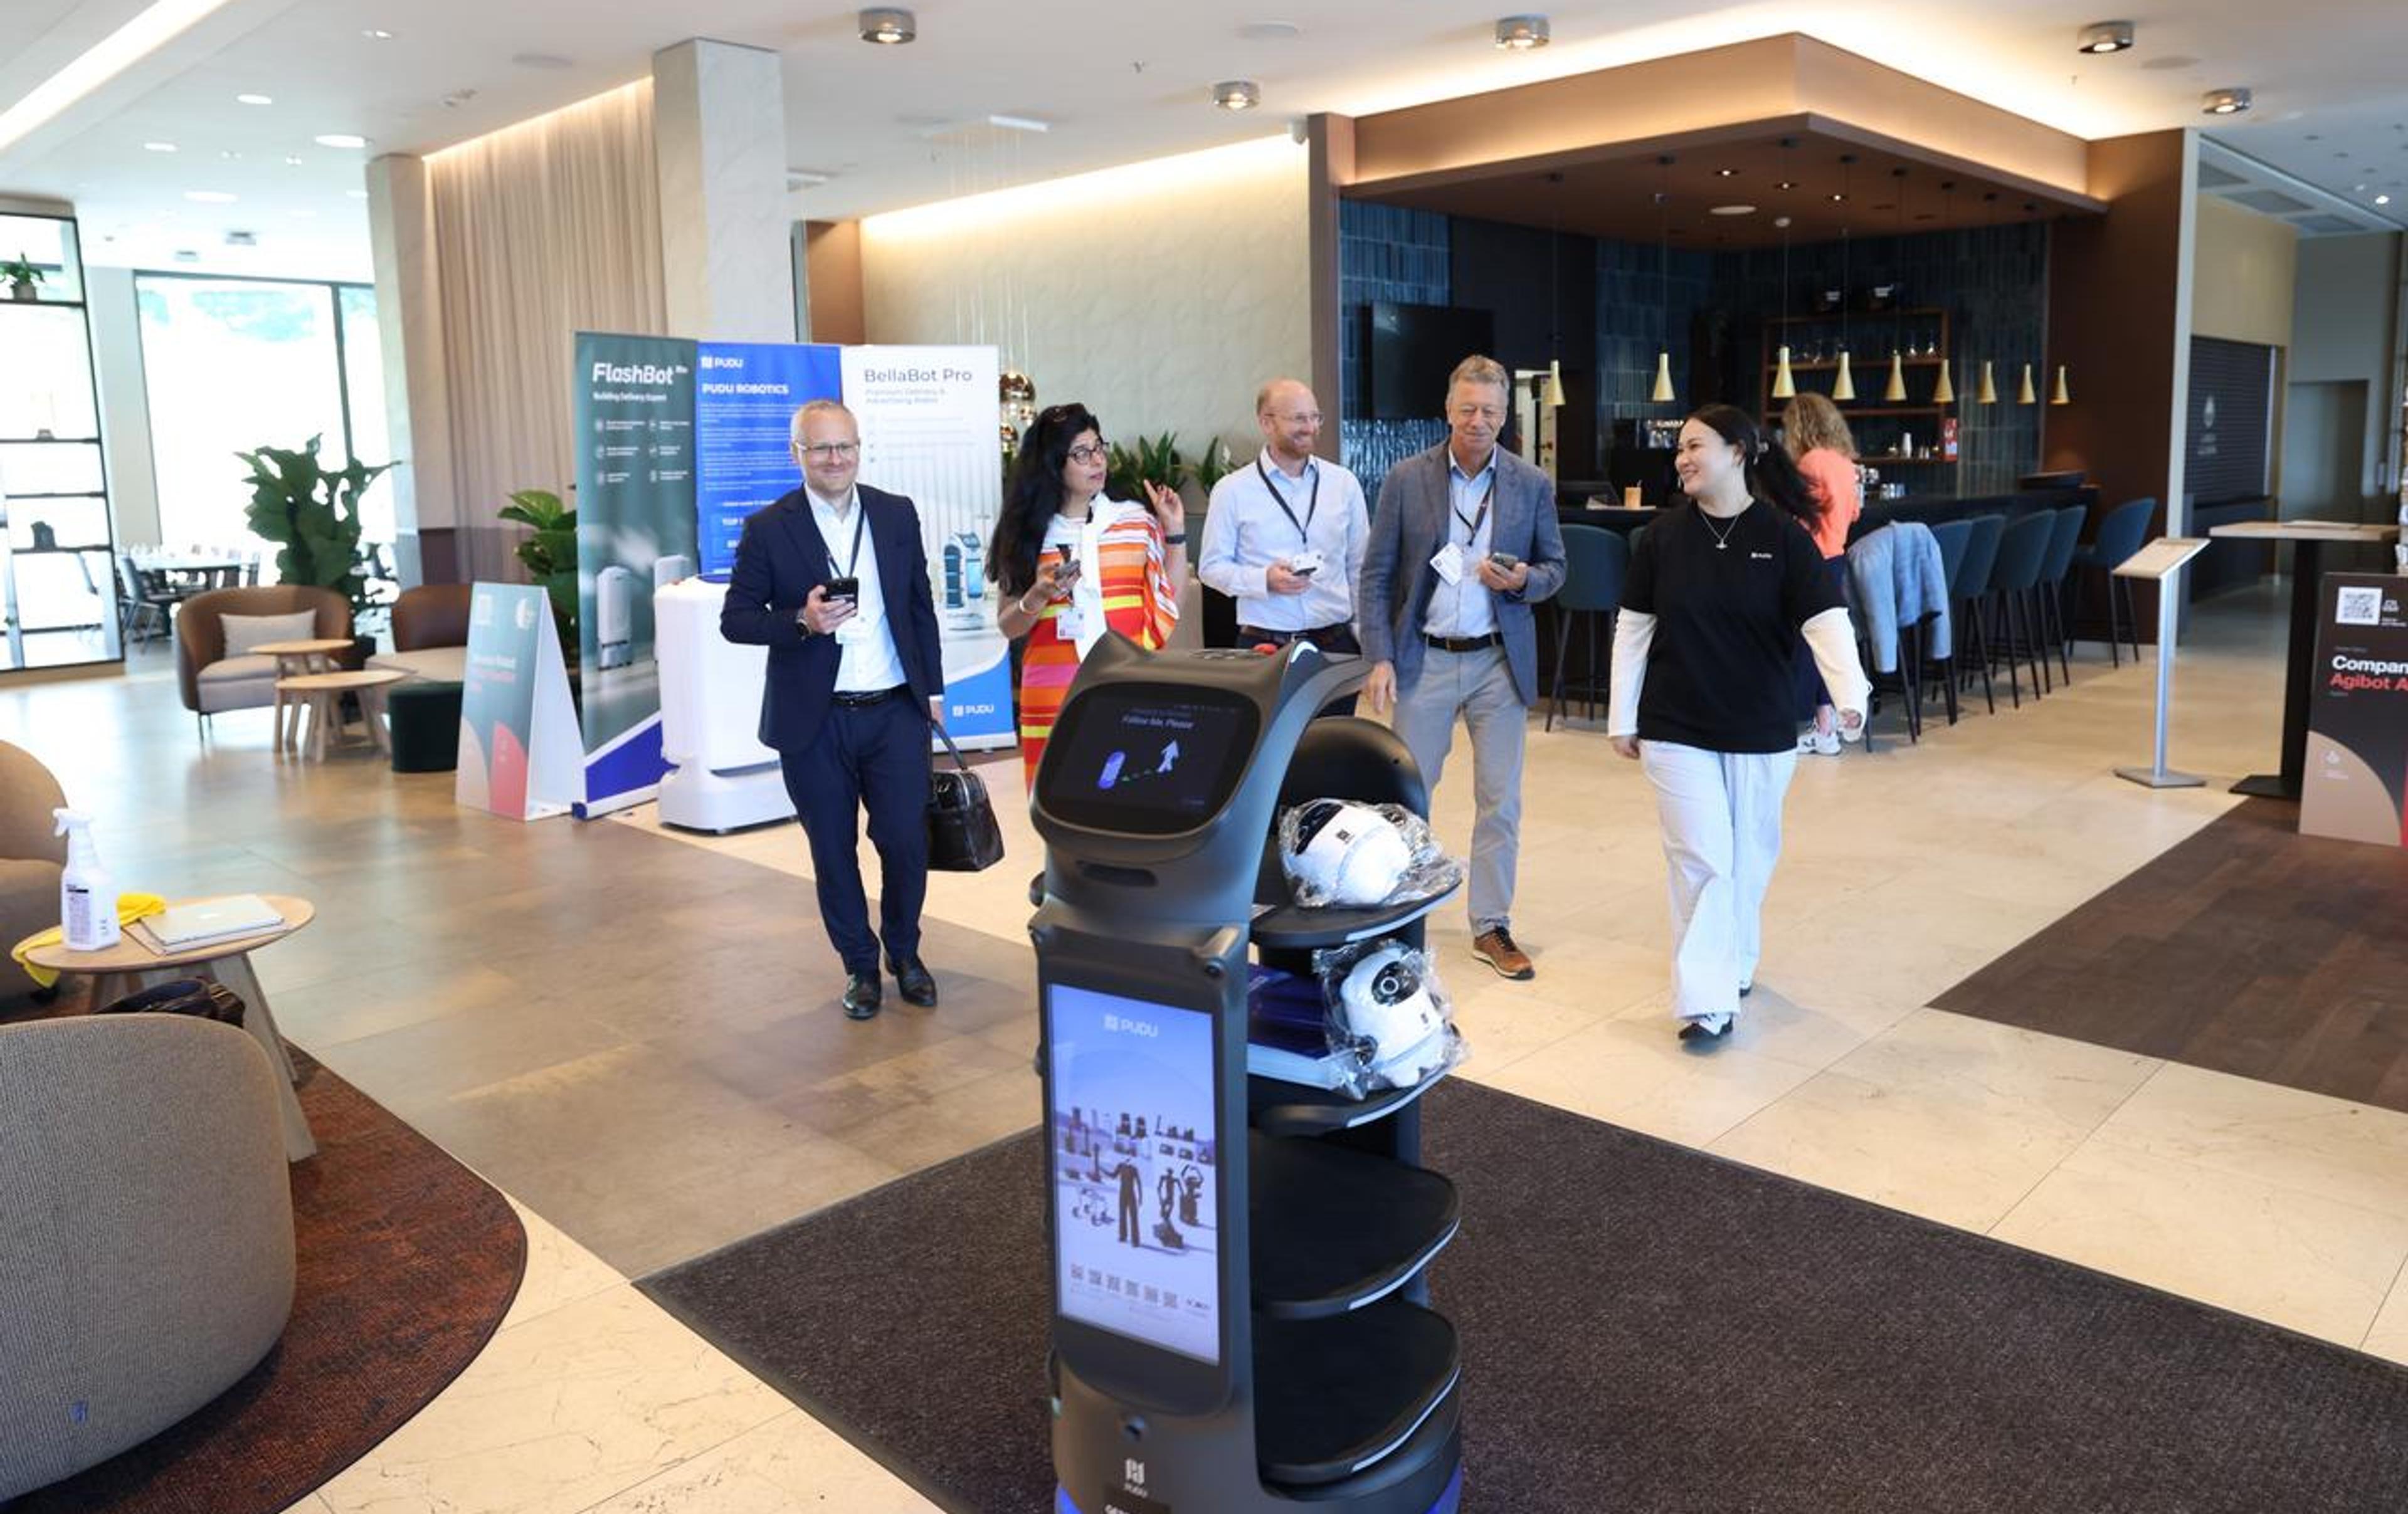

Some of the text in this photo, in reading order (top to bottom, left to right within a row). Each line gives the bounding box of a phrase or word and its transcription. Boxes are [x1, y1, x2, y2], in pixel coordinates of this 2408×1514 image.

[715, 357, 744, 369] PUDU
[593, 362, 674, 386] FlashBot
[864, 368, 973, 383] BellaBot Pro
[702, 383, 789, 395] PUDU ROBOTICS
[2331, 654, 2408, 675] Compan
[2330, 673, 2390, 691] Agibot
[965, 704, 994, 715] PUDU
[1121, 1018, 1158, 1038] PUDU
